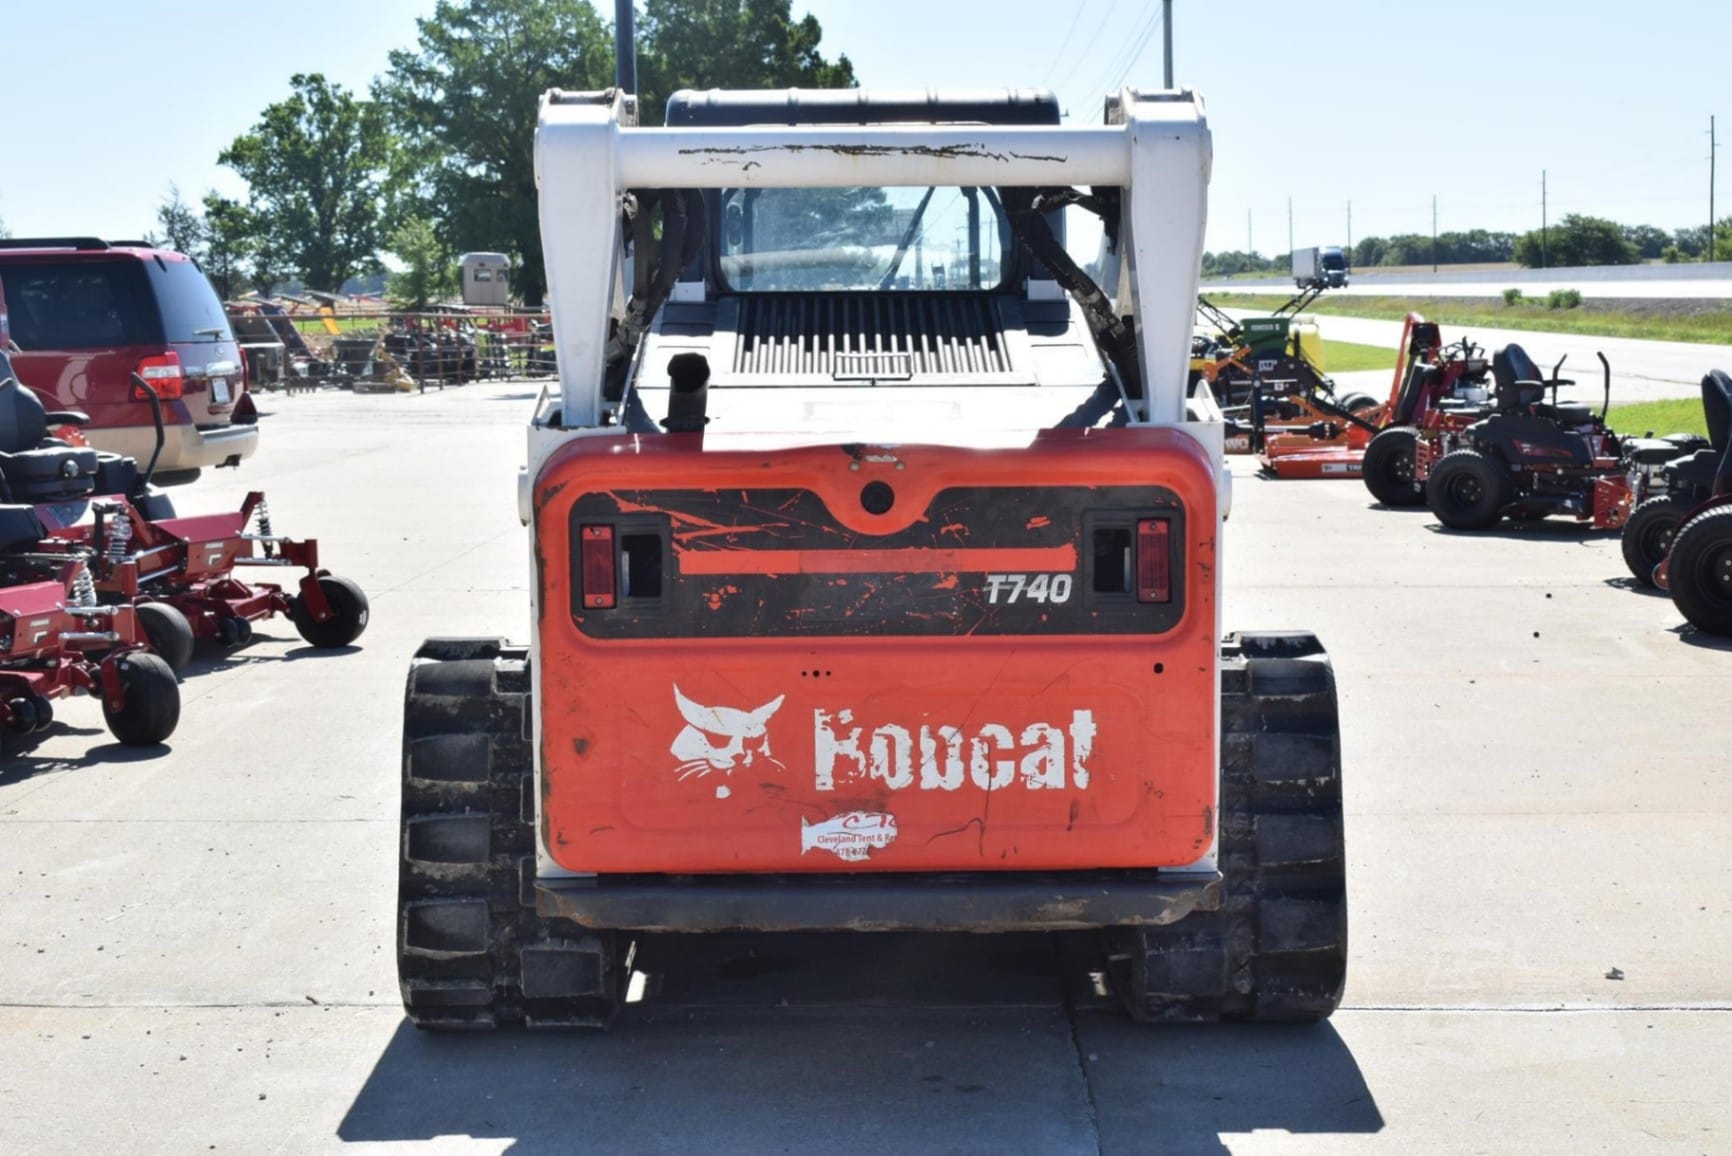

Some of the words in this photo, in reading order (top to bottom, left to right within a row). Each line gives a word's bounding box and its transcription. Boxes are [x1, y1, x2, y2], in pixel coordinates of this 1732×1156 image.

[987, 574, 1073, 604] T740
[817, 834, 855, 843] Cleveland
[858, 834, 875, 842] Tent
[877, 834, 883, 842] &
